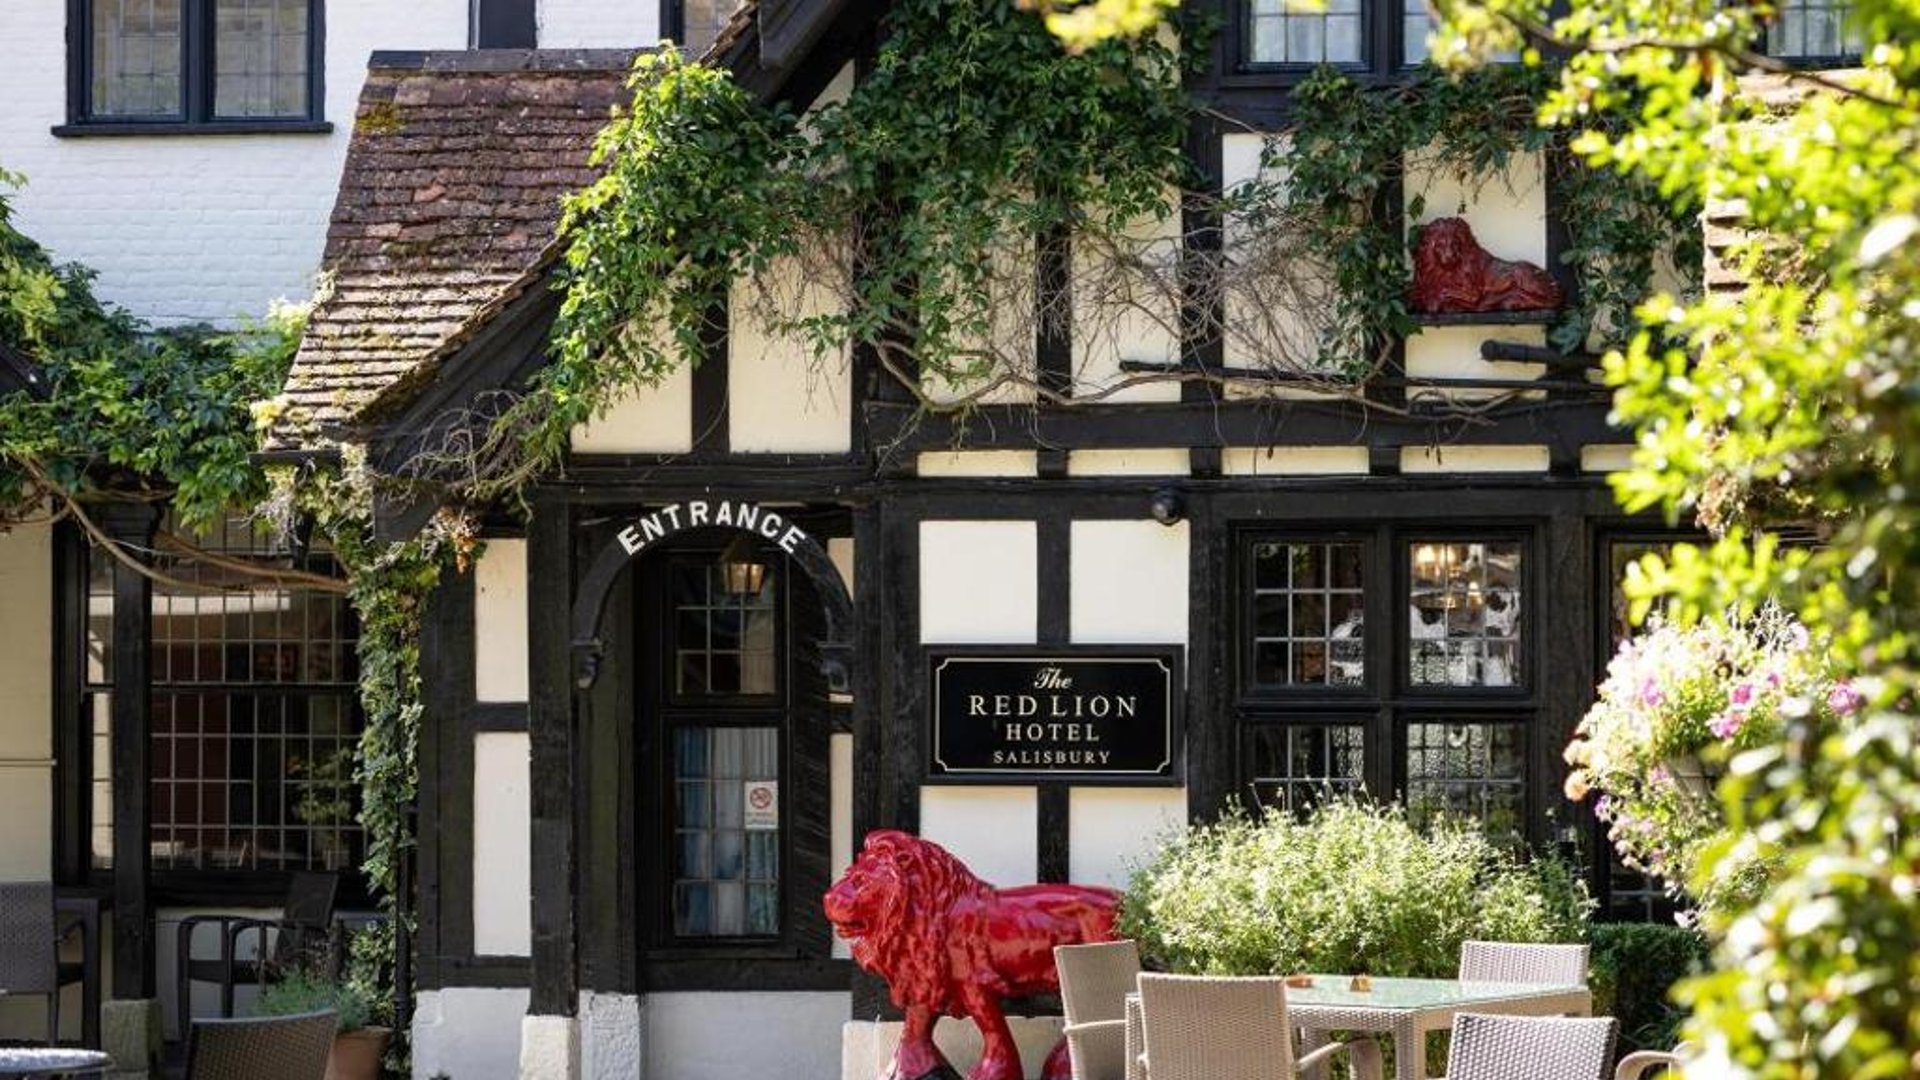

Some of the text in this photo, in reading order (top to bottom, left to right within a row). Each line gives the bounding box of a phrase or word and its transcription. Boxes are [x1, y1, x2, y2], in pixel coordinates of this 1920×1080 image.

[616, 500, 805, 556] ENTRANCE
[1034, 667, 1073, 690] The
[968, 694, 1137, 718] RED LION
[1005, 722, 1100, 742] HOTEL
[993, 750, 1111, 764] SALISBURY
